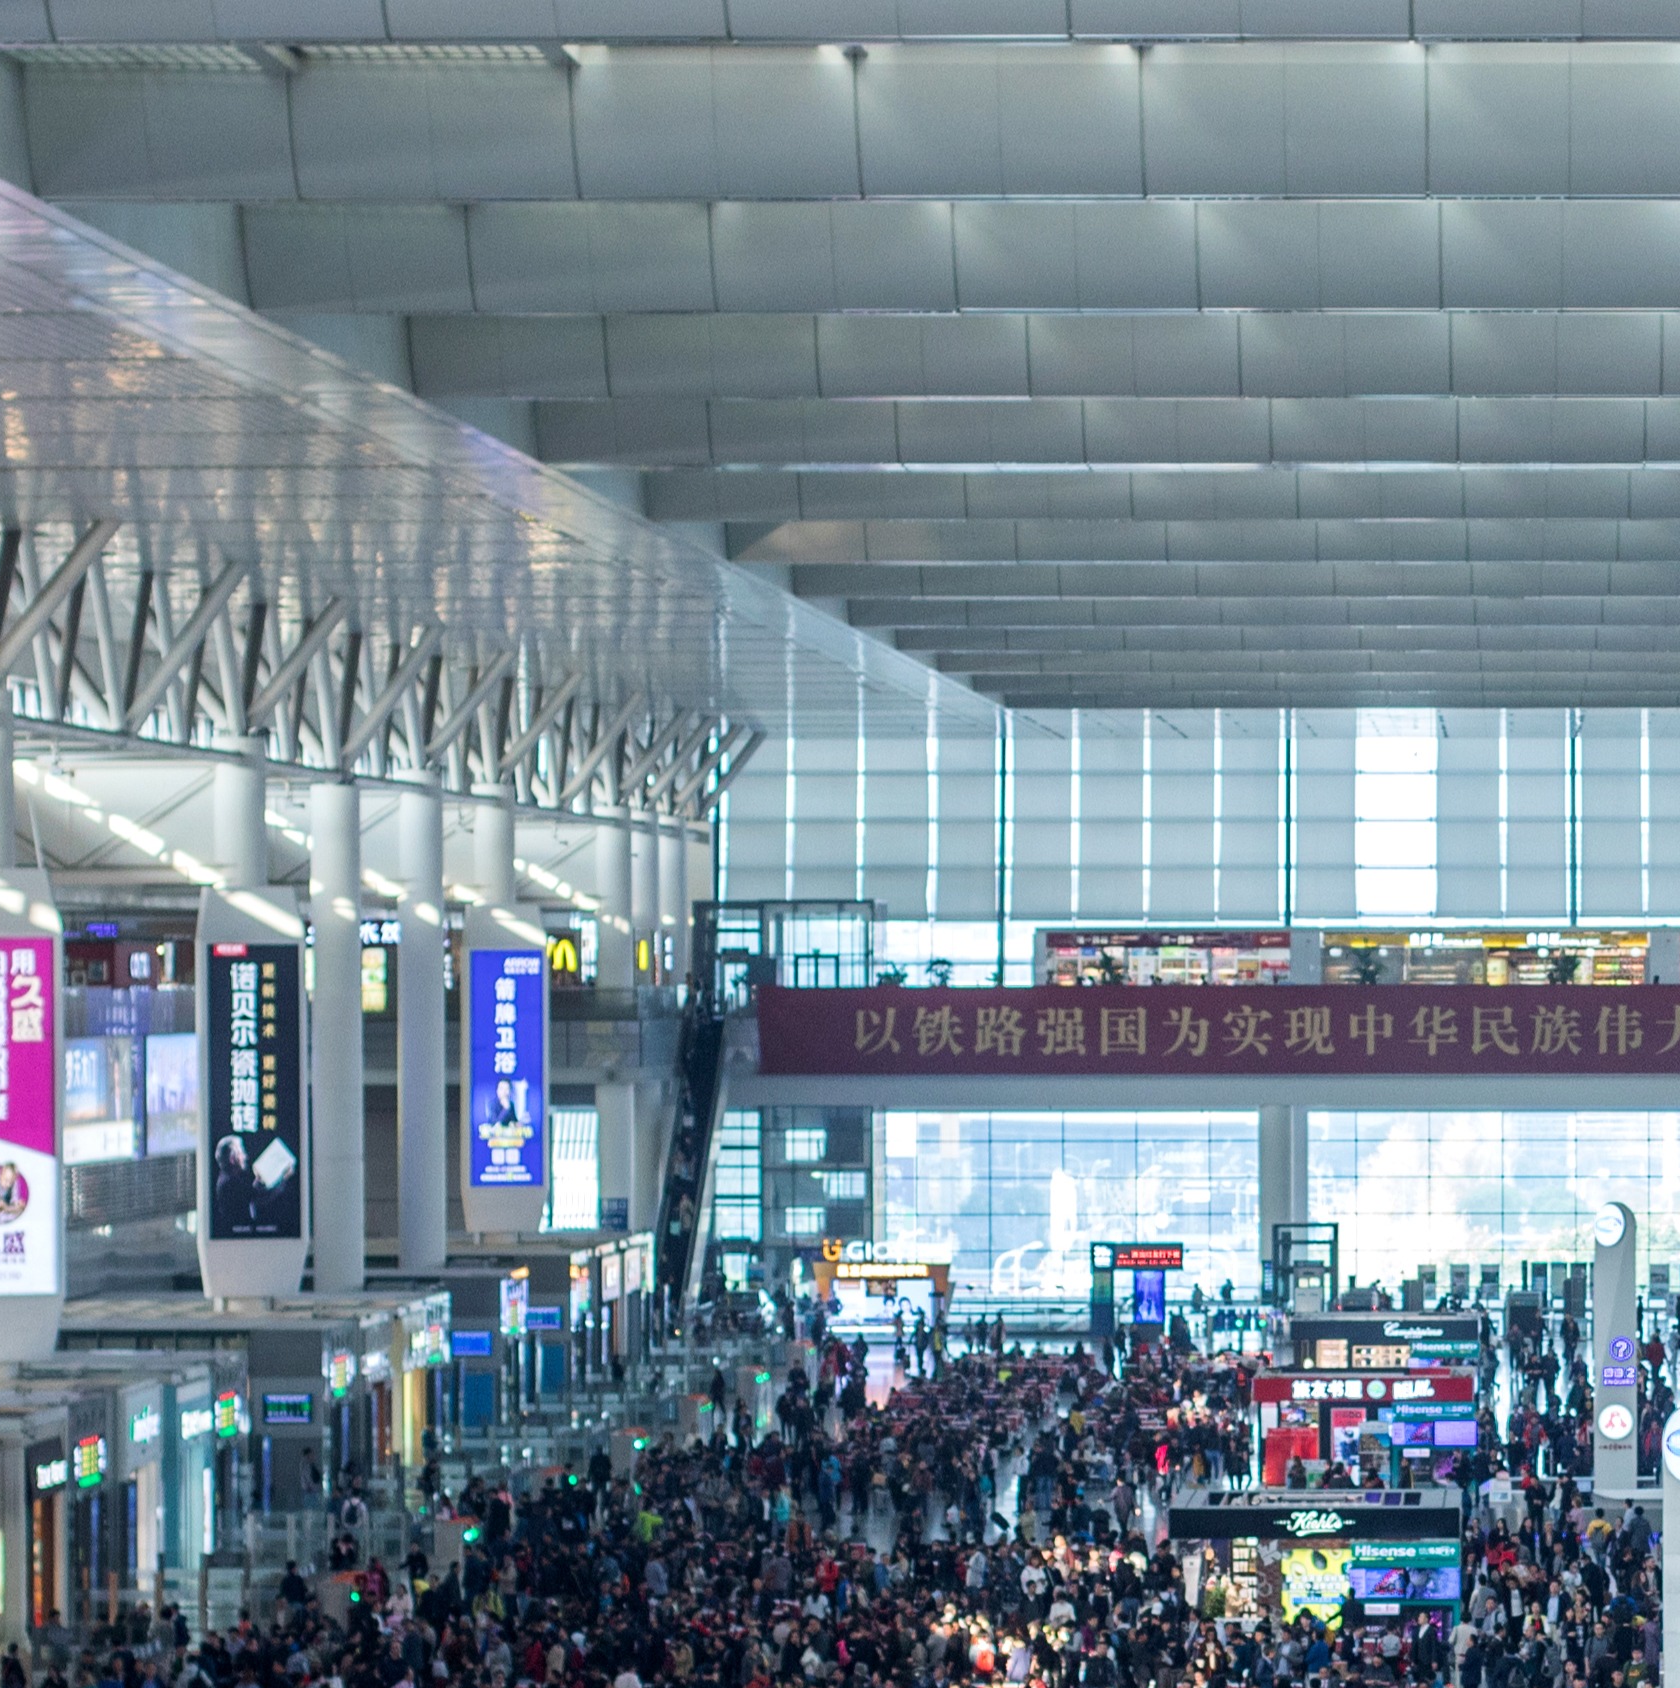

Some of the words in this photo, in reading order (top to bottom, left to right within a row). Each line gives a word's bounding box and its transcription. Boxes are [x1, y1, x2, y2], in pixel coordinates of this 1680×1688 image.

[10, 948, 44, 1042] 用久盛
[1625, 1367, 1636, 1378] 2
[1290, 1380, 1362, 1399] 旅友书屋
[1286, 1510, 1345, 1537] Kiehl's
[1355, 1546, 1417, 1557] Hisense
